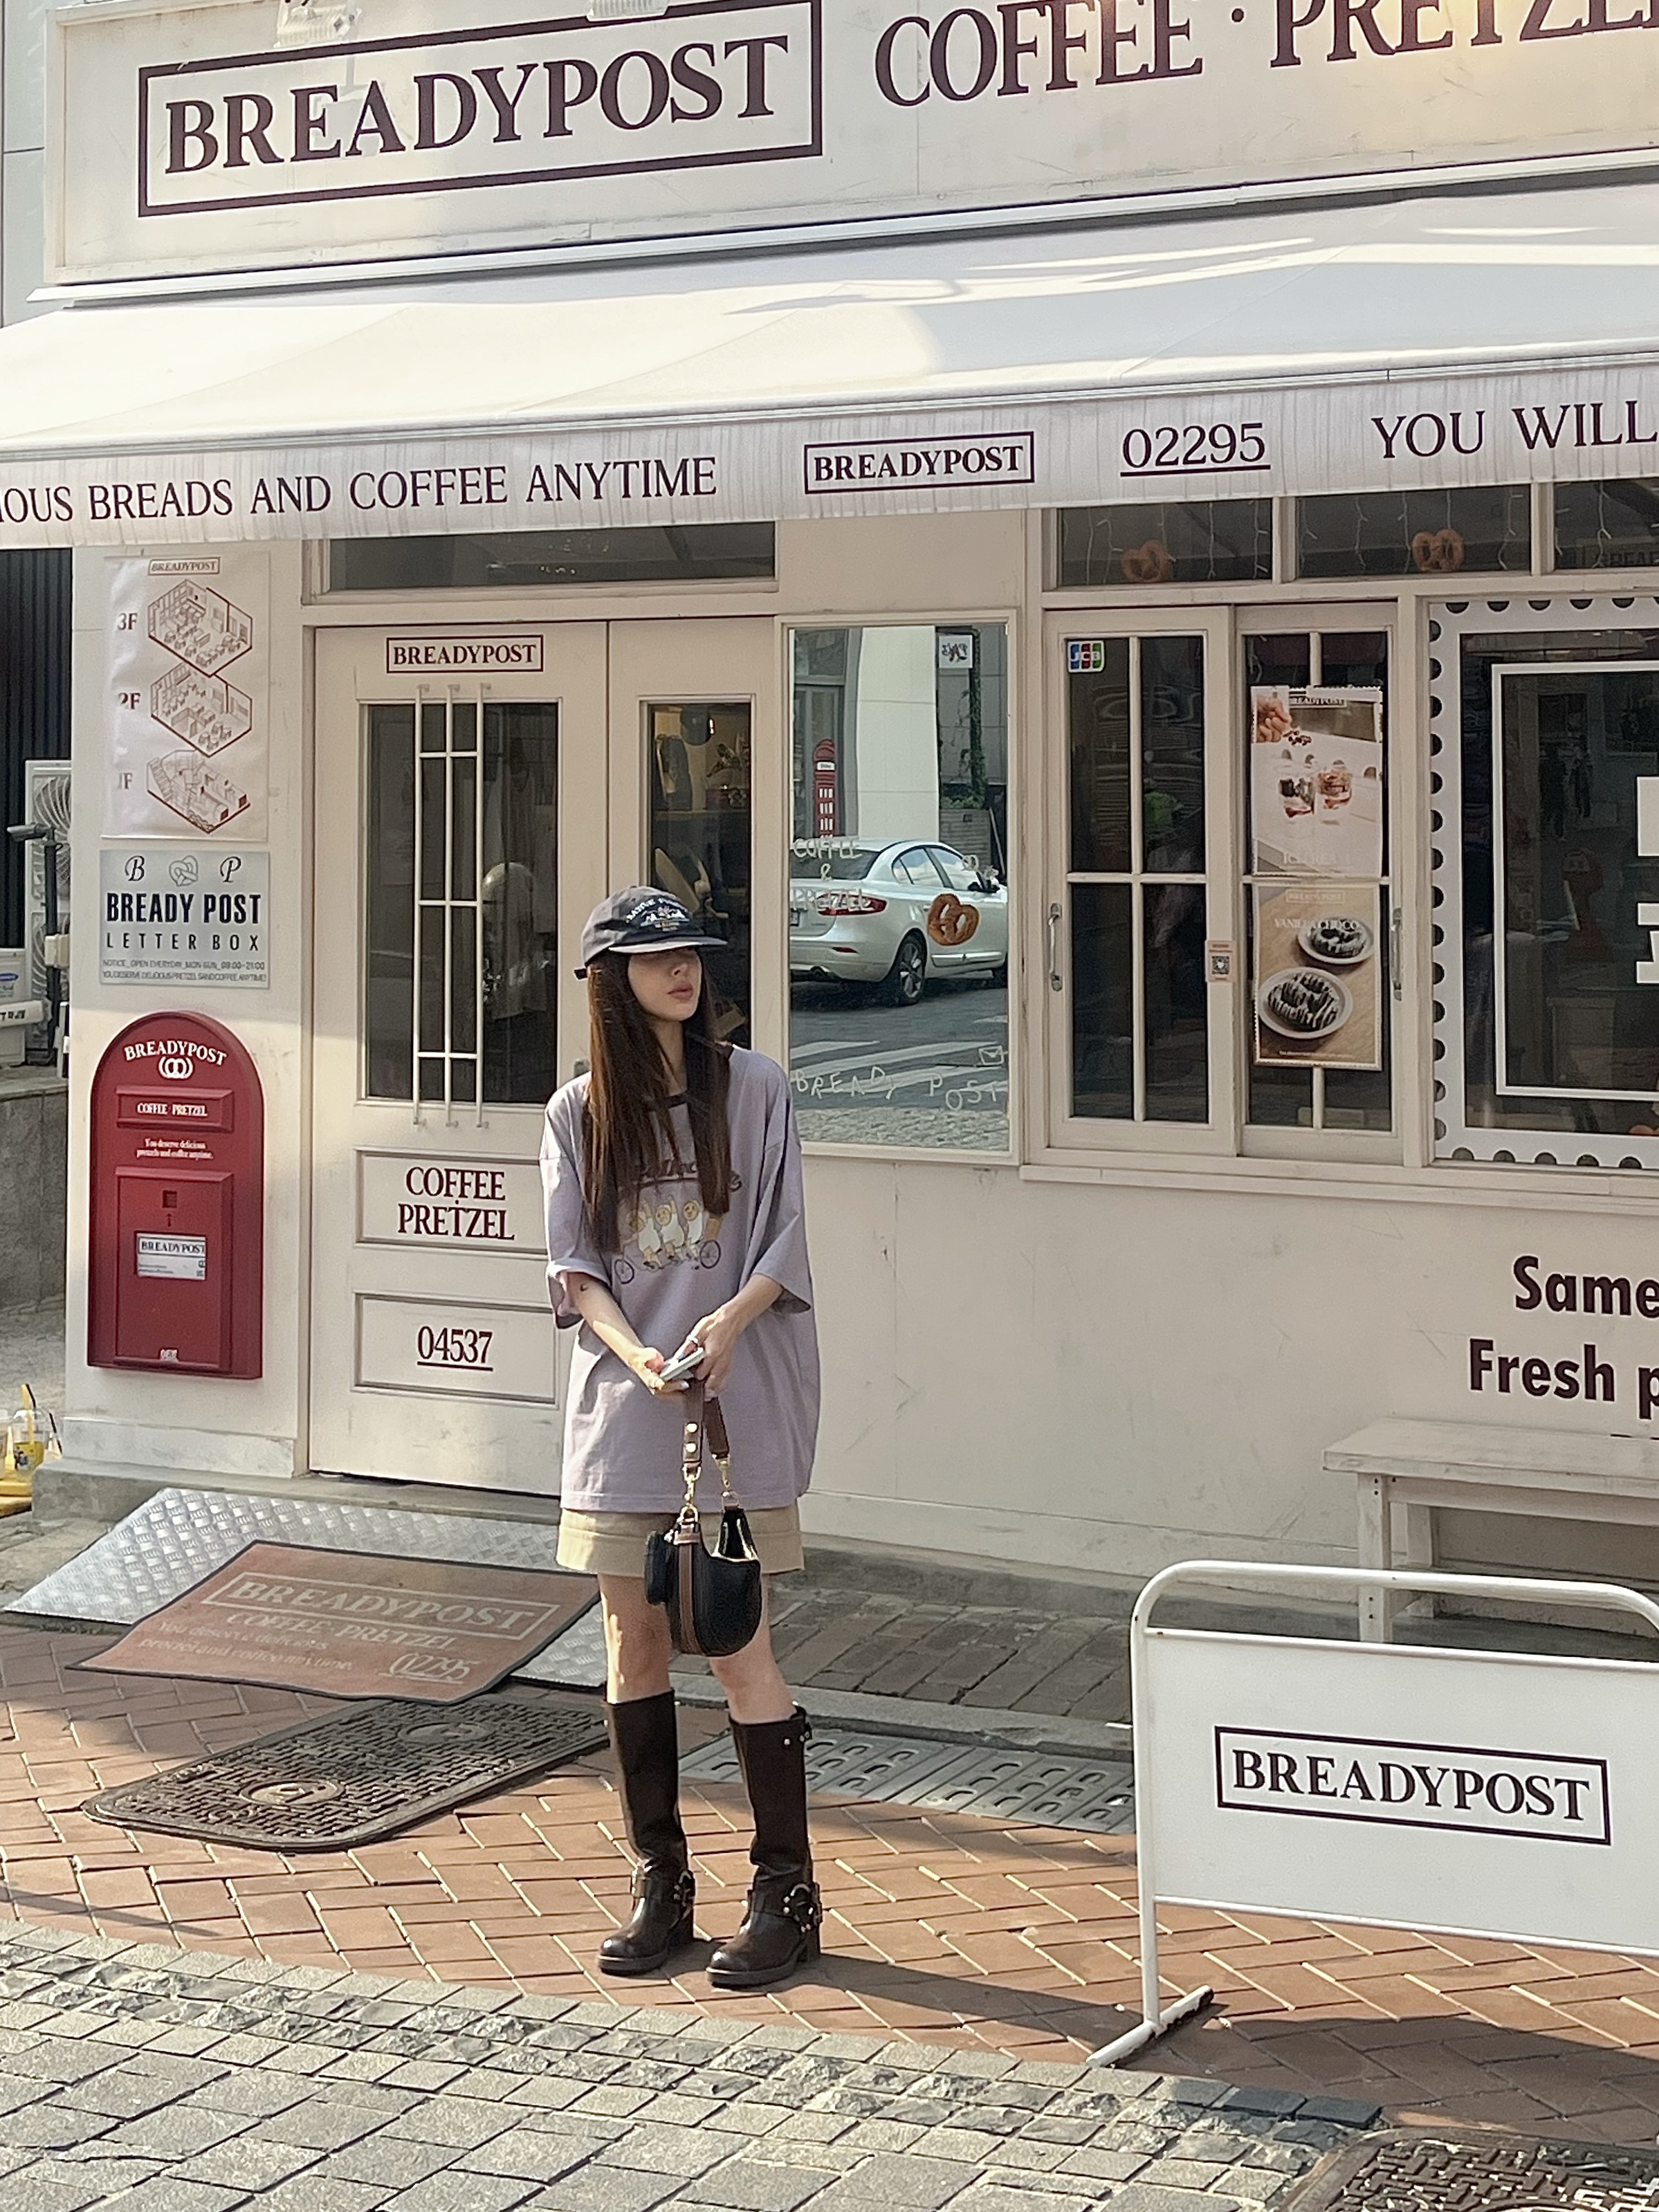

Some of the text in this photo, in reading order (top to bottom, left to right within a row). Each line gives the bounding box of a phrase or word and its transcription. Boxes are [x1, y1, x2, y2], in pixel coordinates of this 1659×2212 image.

[875, 0, 1659, 106] COFFEE PRETZ
[165, 36, 789, 174] BREADYPOST
[1123, 422, 1265, 468] 02295
[1371, 401, 1659, 459] YOU WILL
[814, 446, 1023, 482] BREADYPOST
[89, 479, 232, 520] BREADS
[250, 475, 331, 514] AND
[350, 466, 507, 510] COFFEE
[526, 457, 717, 503] ANYTIME
[152, 561, 217, 572] BREADYPOST
[118, 613, 138, 630] 3F
[394, 644, 536, 665] BREADYPOST
[118, 693, 140, 710] 2F
[125, 855, 241, 883] B P
[107, 893, 261, 924] BREADY POST
[107, 933, 259, 951] LETTER BOX
[124, 1041, 227, 1066] BREADYPOST
[137, 1103, 208, 1116] COFFEE PRETZEL
[406, 1167, 506, 1200] COFFEE
[398, 1203, 514, 1241] PRETZEL
[1513, 1255, 1659, 1318] Same
[418, 1326, 493, 1364] 04537
[1469, 1338, 1615, 1402] Fresh
[228, 1581, 534, 1629] BREADYPOST
[227, 1613, 332, 1634] COFFEE
[1232, 1749, 1590, 1820] BREADYPOST
